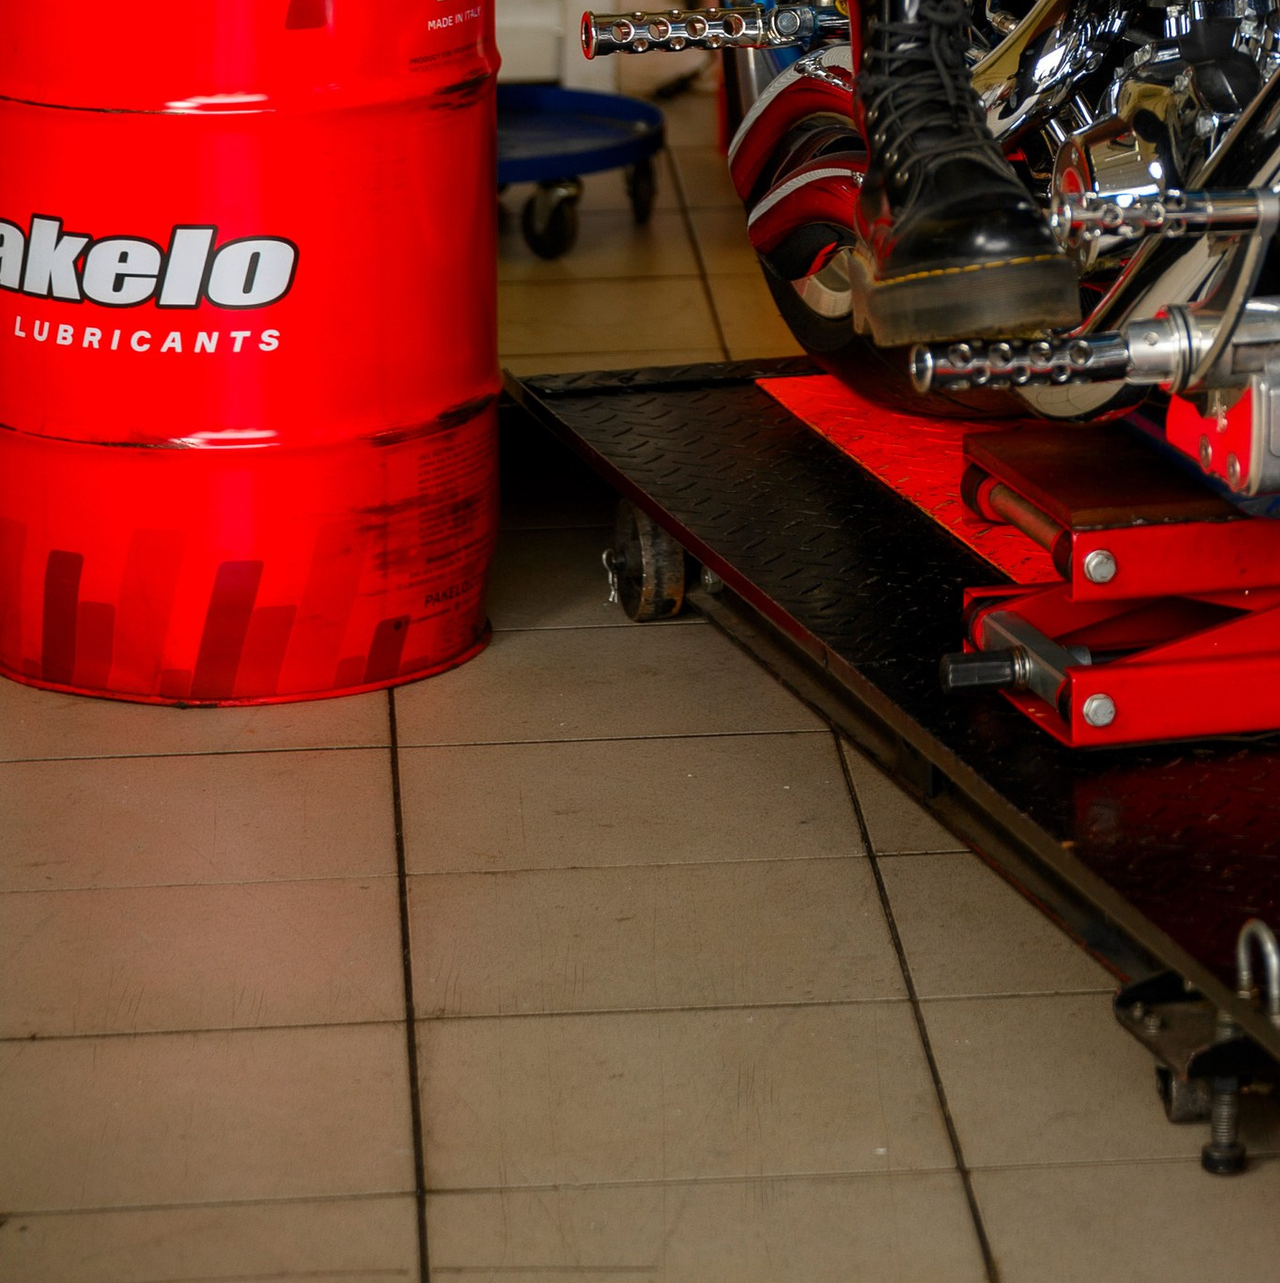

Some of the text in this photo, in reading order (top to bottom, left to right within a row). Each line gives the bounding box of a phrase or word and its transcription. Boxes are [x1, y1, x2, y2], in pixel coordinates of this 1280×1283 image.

[427, 6, 481, 31] MADE IN ITALY
[14, 315, 280, 354] LUBRICANTS
